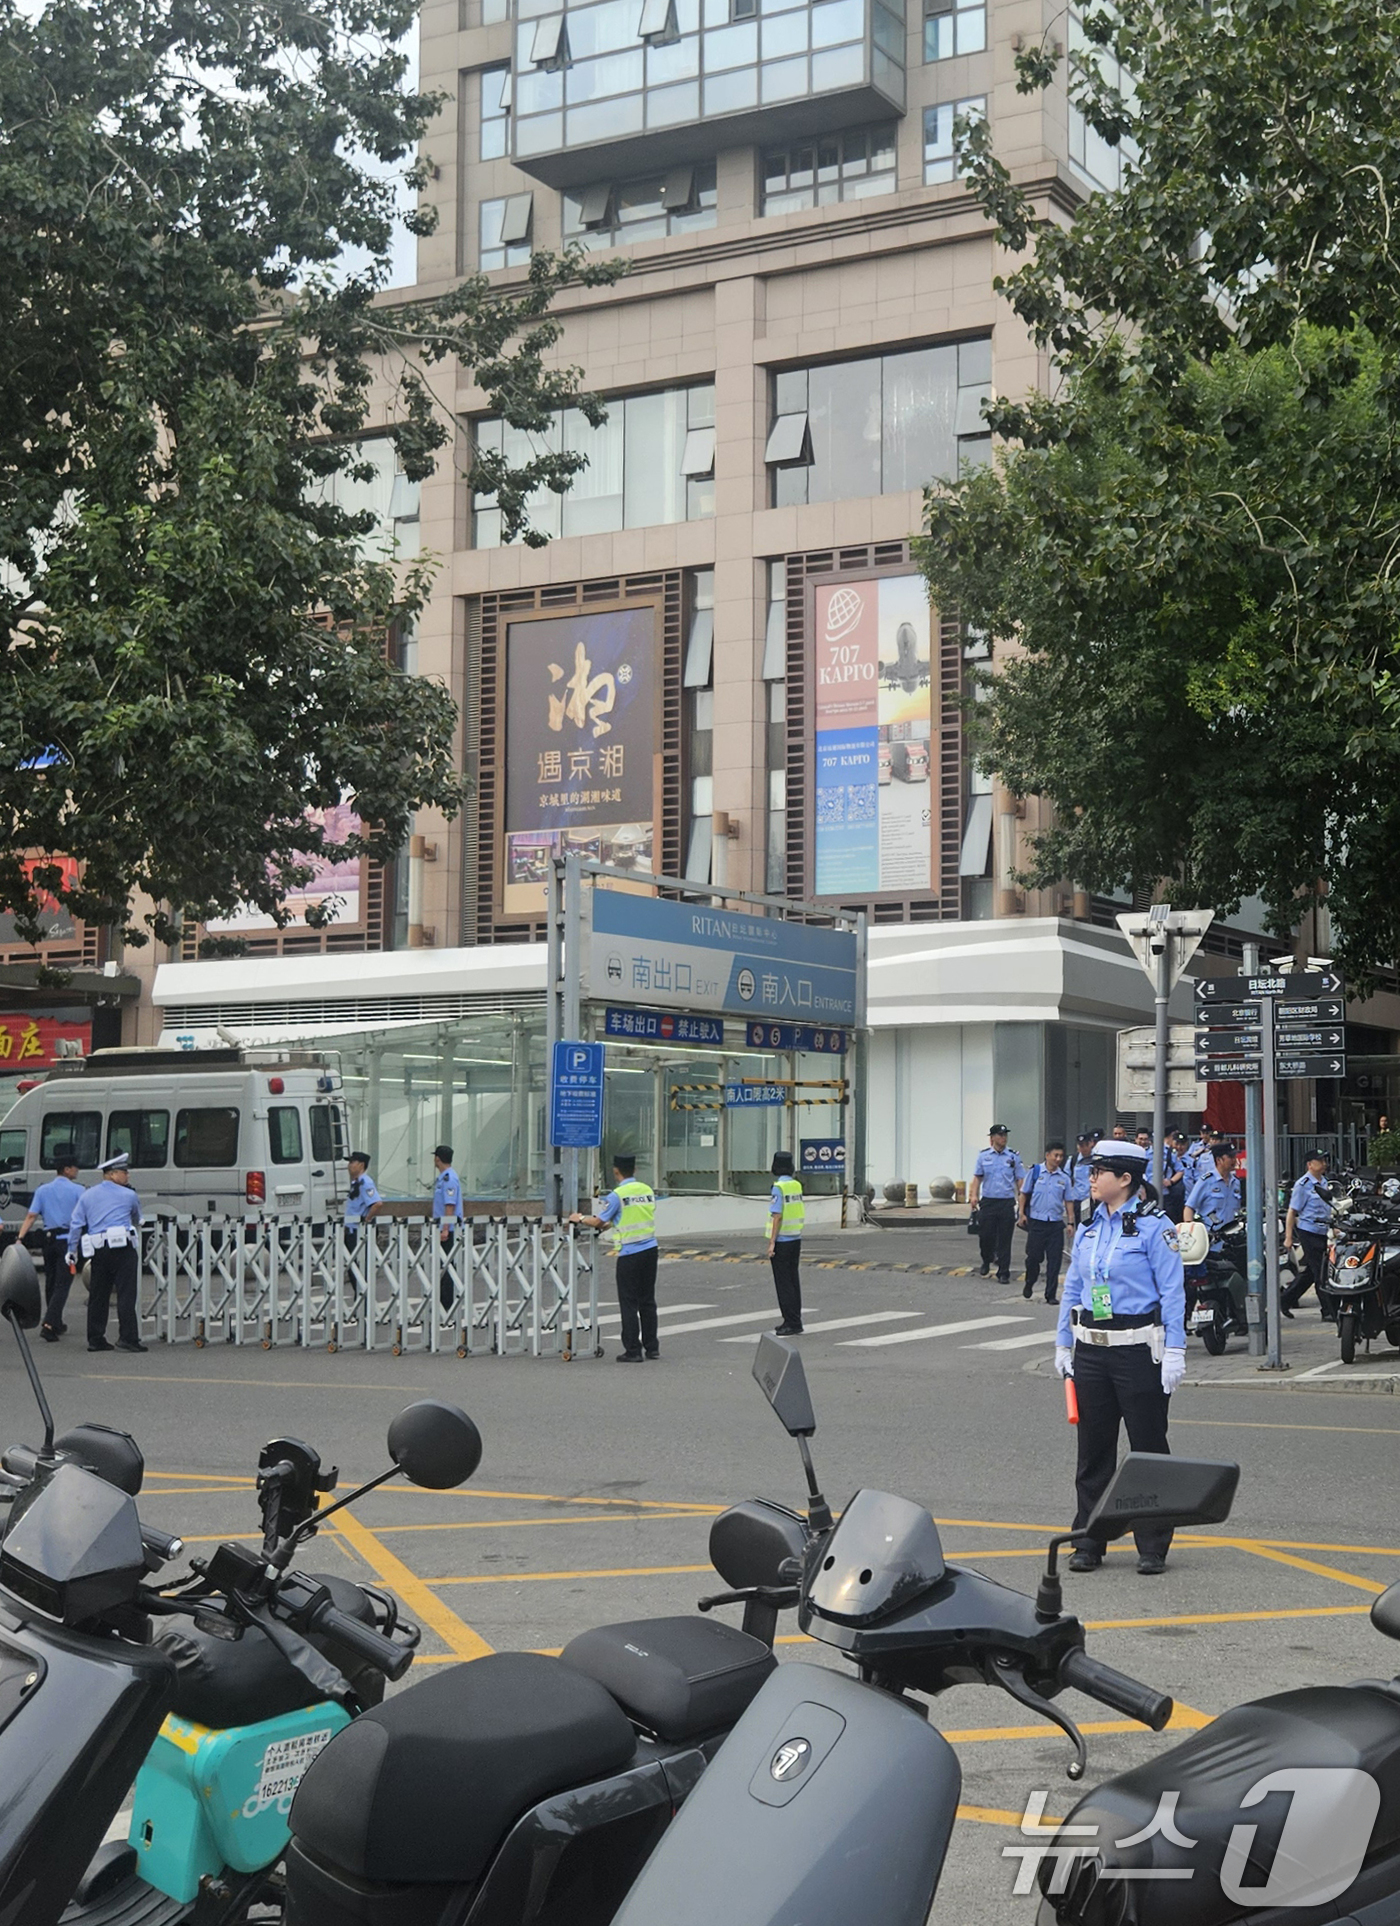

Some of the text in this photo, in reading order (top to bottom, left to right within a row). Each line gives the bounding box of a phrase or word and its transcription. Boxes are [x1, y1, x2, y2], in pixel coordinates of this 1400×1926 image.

[830, 644, 861, 665] 707
[820, 662, 875, 685] КАРГО
[537, 744, 625, 784] 遇京湘
[822, 753, 871, 767] 707 КАРГО
[692, 915, 732, 939] RITAN
[631, 954, 719, 996] 南出口 EXIT
[1248, 978, 1287, 990] 日坛北路
[762, 971, 853, 1013] 南入口 ENTRANCE
[610, 1012, 720, 1041] 车场出口 禁止驶入
[772, 1030, 780, 1045] 5
[794, 1028, 802, 1044] P
[572, 1052, 587, 1068] P
[560, 1075, 598, 1085] 收费停车
[726, 1087, 786, 1103] 南入口限高2米
